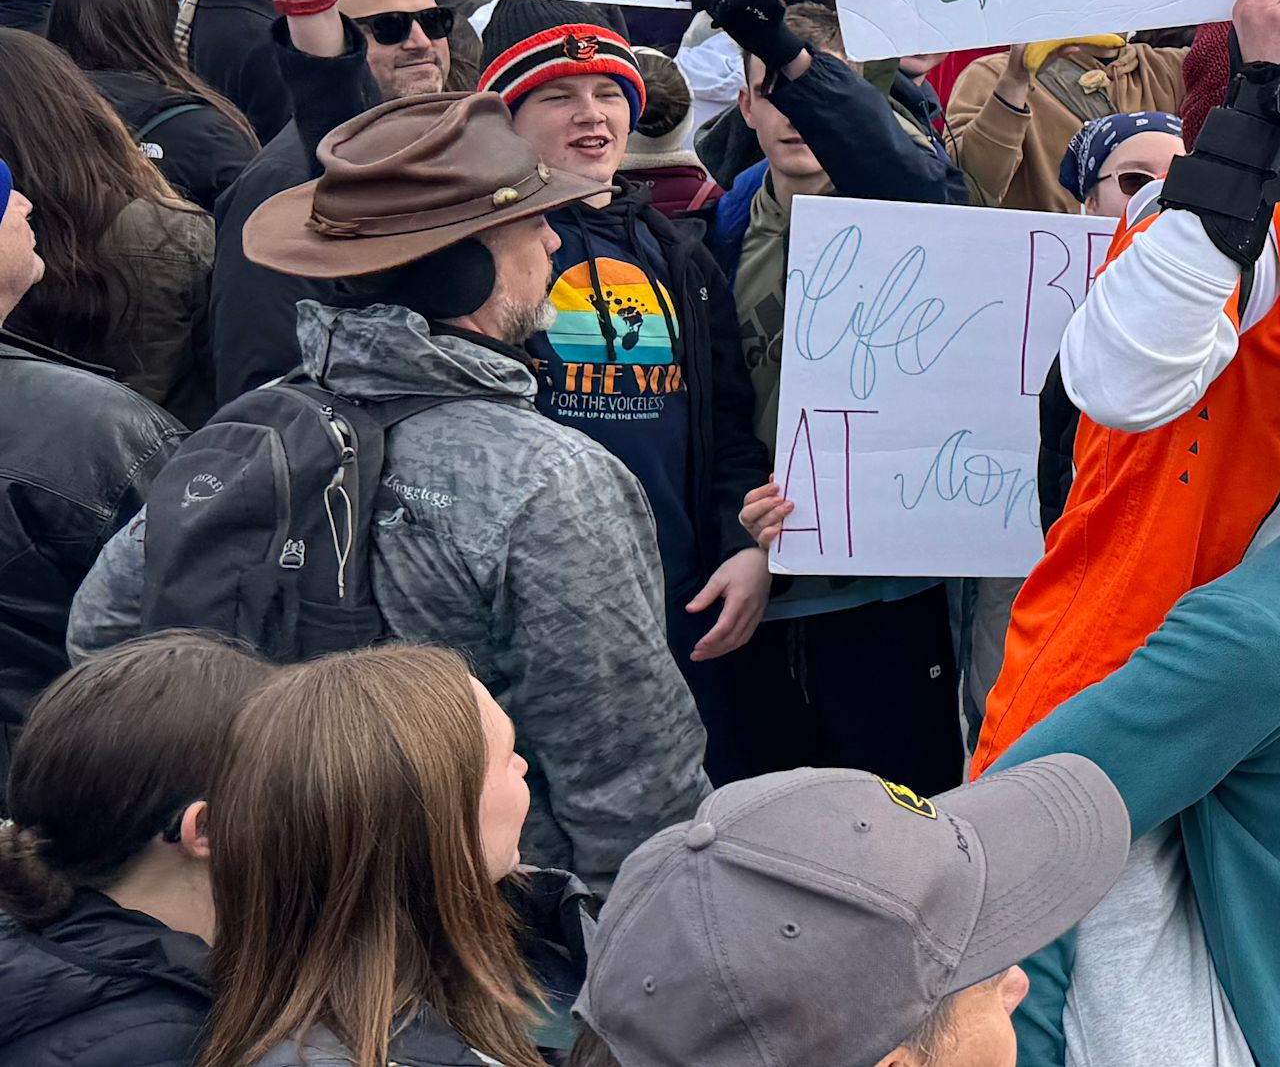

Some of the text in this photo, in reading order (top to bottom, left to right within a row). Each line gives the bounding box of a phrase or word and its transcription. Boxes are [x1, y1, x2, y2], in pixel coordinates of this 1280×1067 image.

[550, 390, 666, 413] FOR THE VOICELESS
[777, 407, 880, 558] AT
